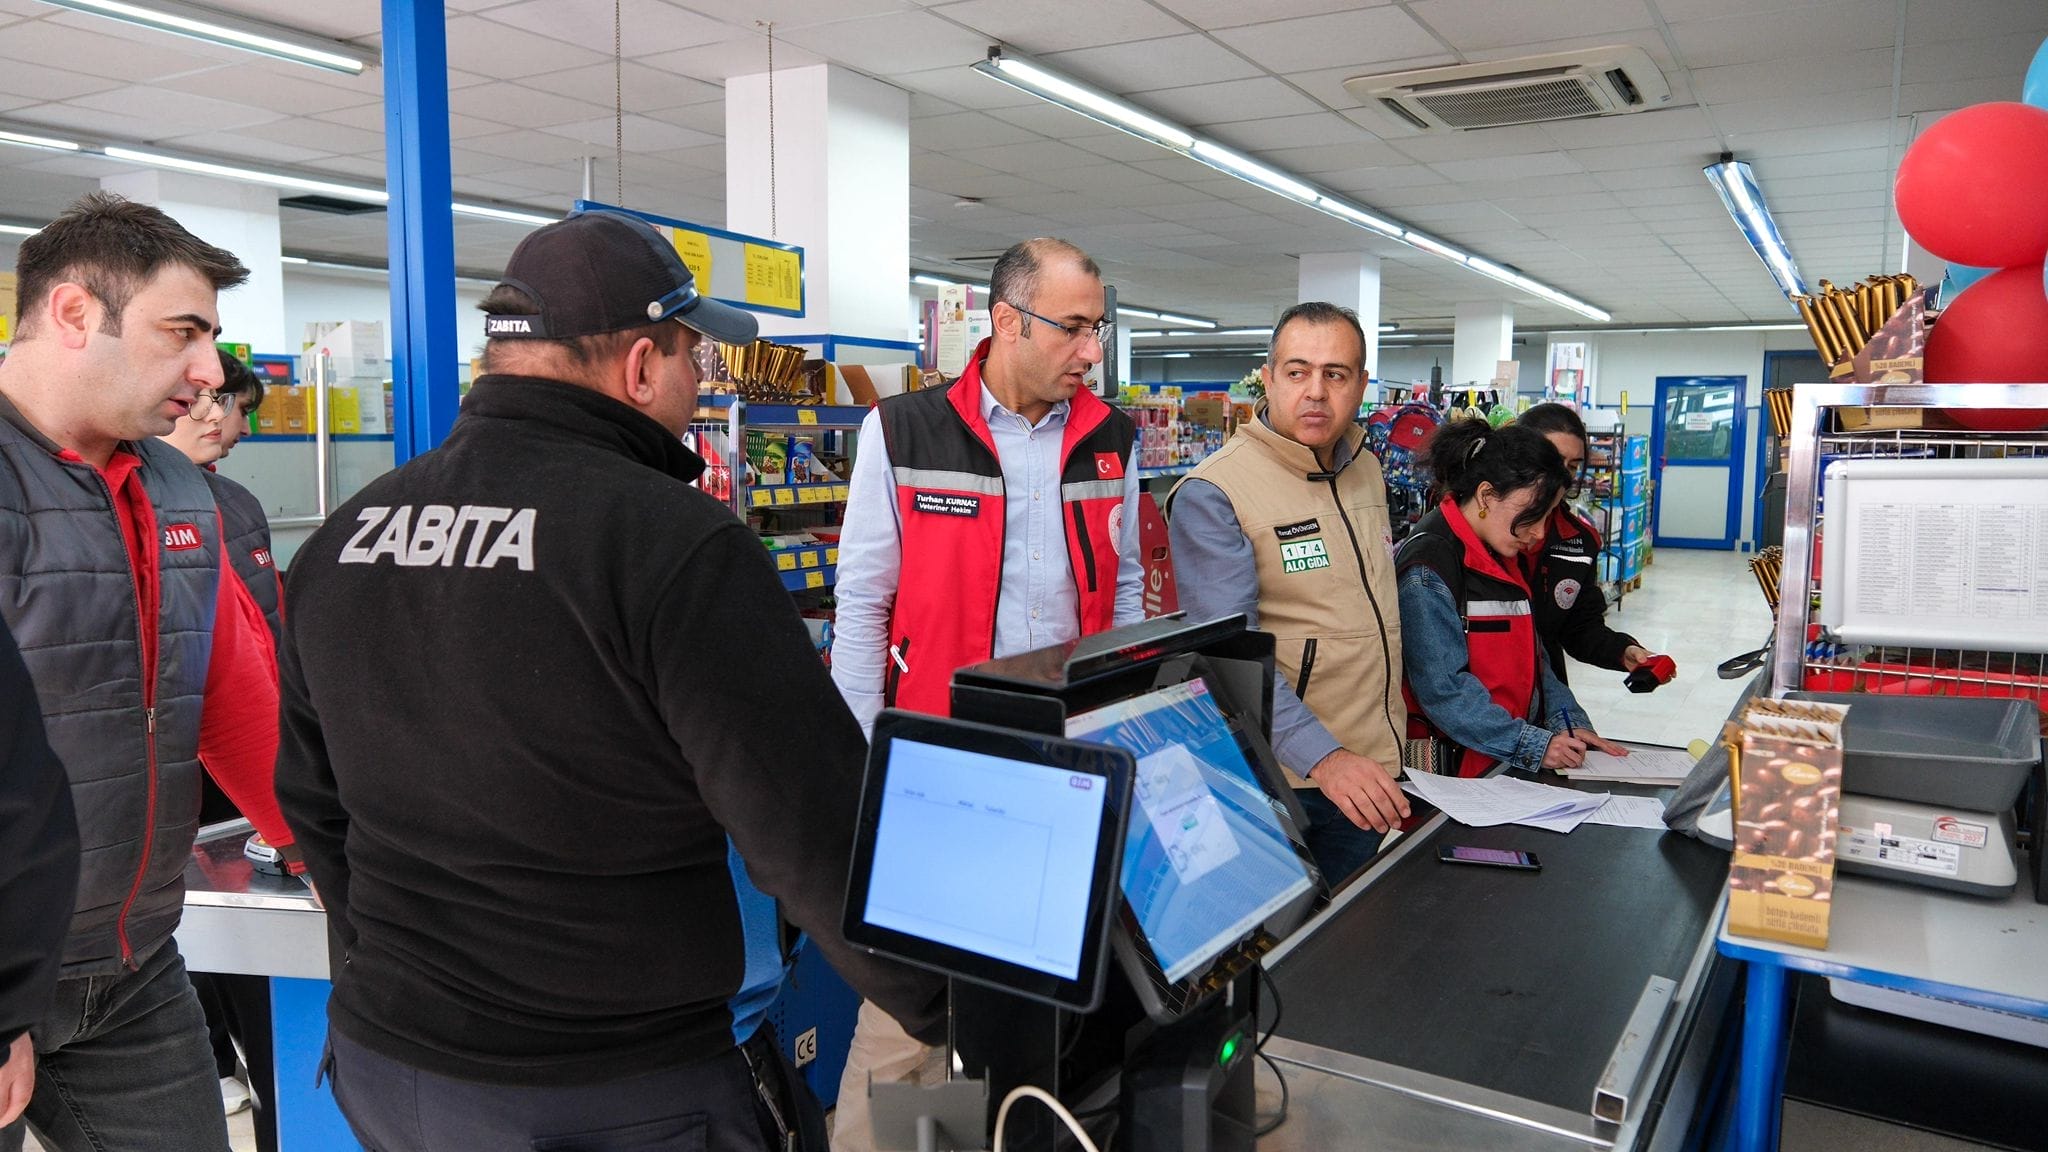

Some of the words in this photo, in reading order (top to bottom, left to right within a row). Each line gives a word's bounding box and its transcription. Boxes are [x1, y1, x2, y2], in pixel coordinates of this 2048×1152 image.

[490, 319, 532, 333] ZABITA
[916, 494, 944, 504] Turhan
[945, 497, 977, 508] KURNAZ
[919, 503, 949, 512] Veteriner
[950, 506, 972, 514] Hekim
[165, 528, 197, 546] BIM
[338, 504, 537, 571] ZABITA
[1285, 559, 1306, 573] ALO
[1306, 556, 1329, 569] GIDA
